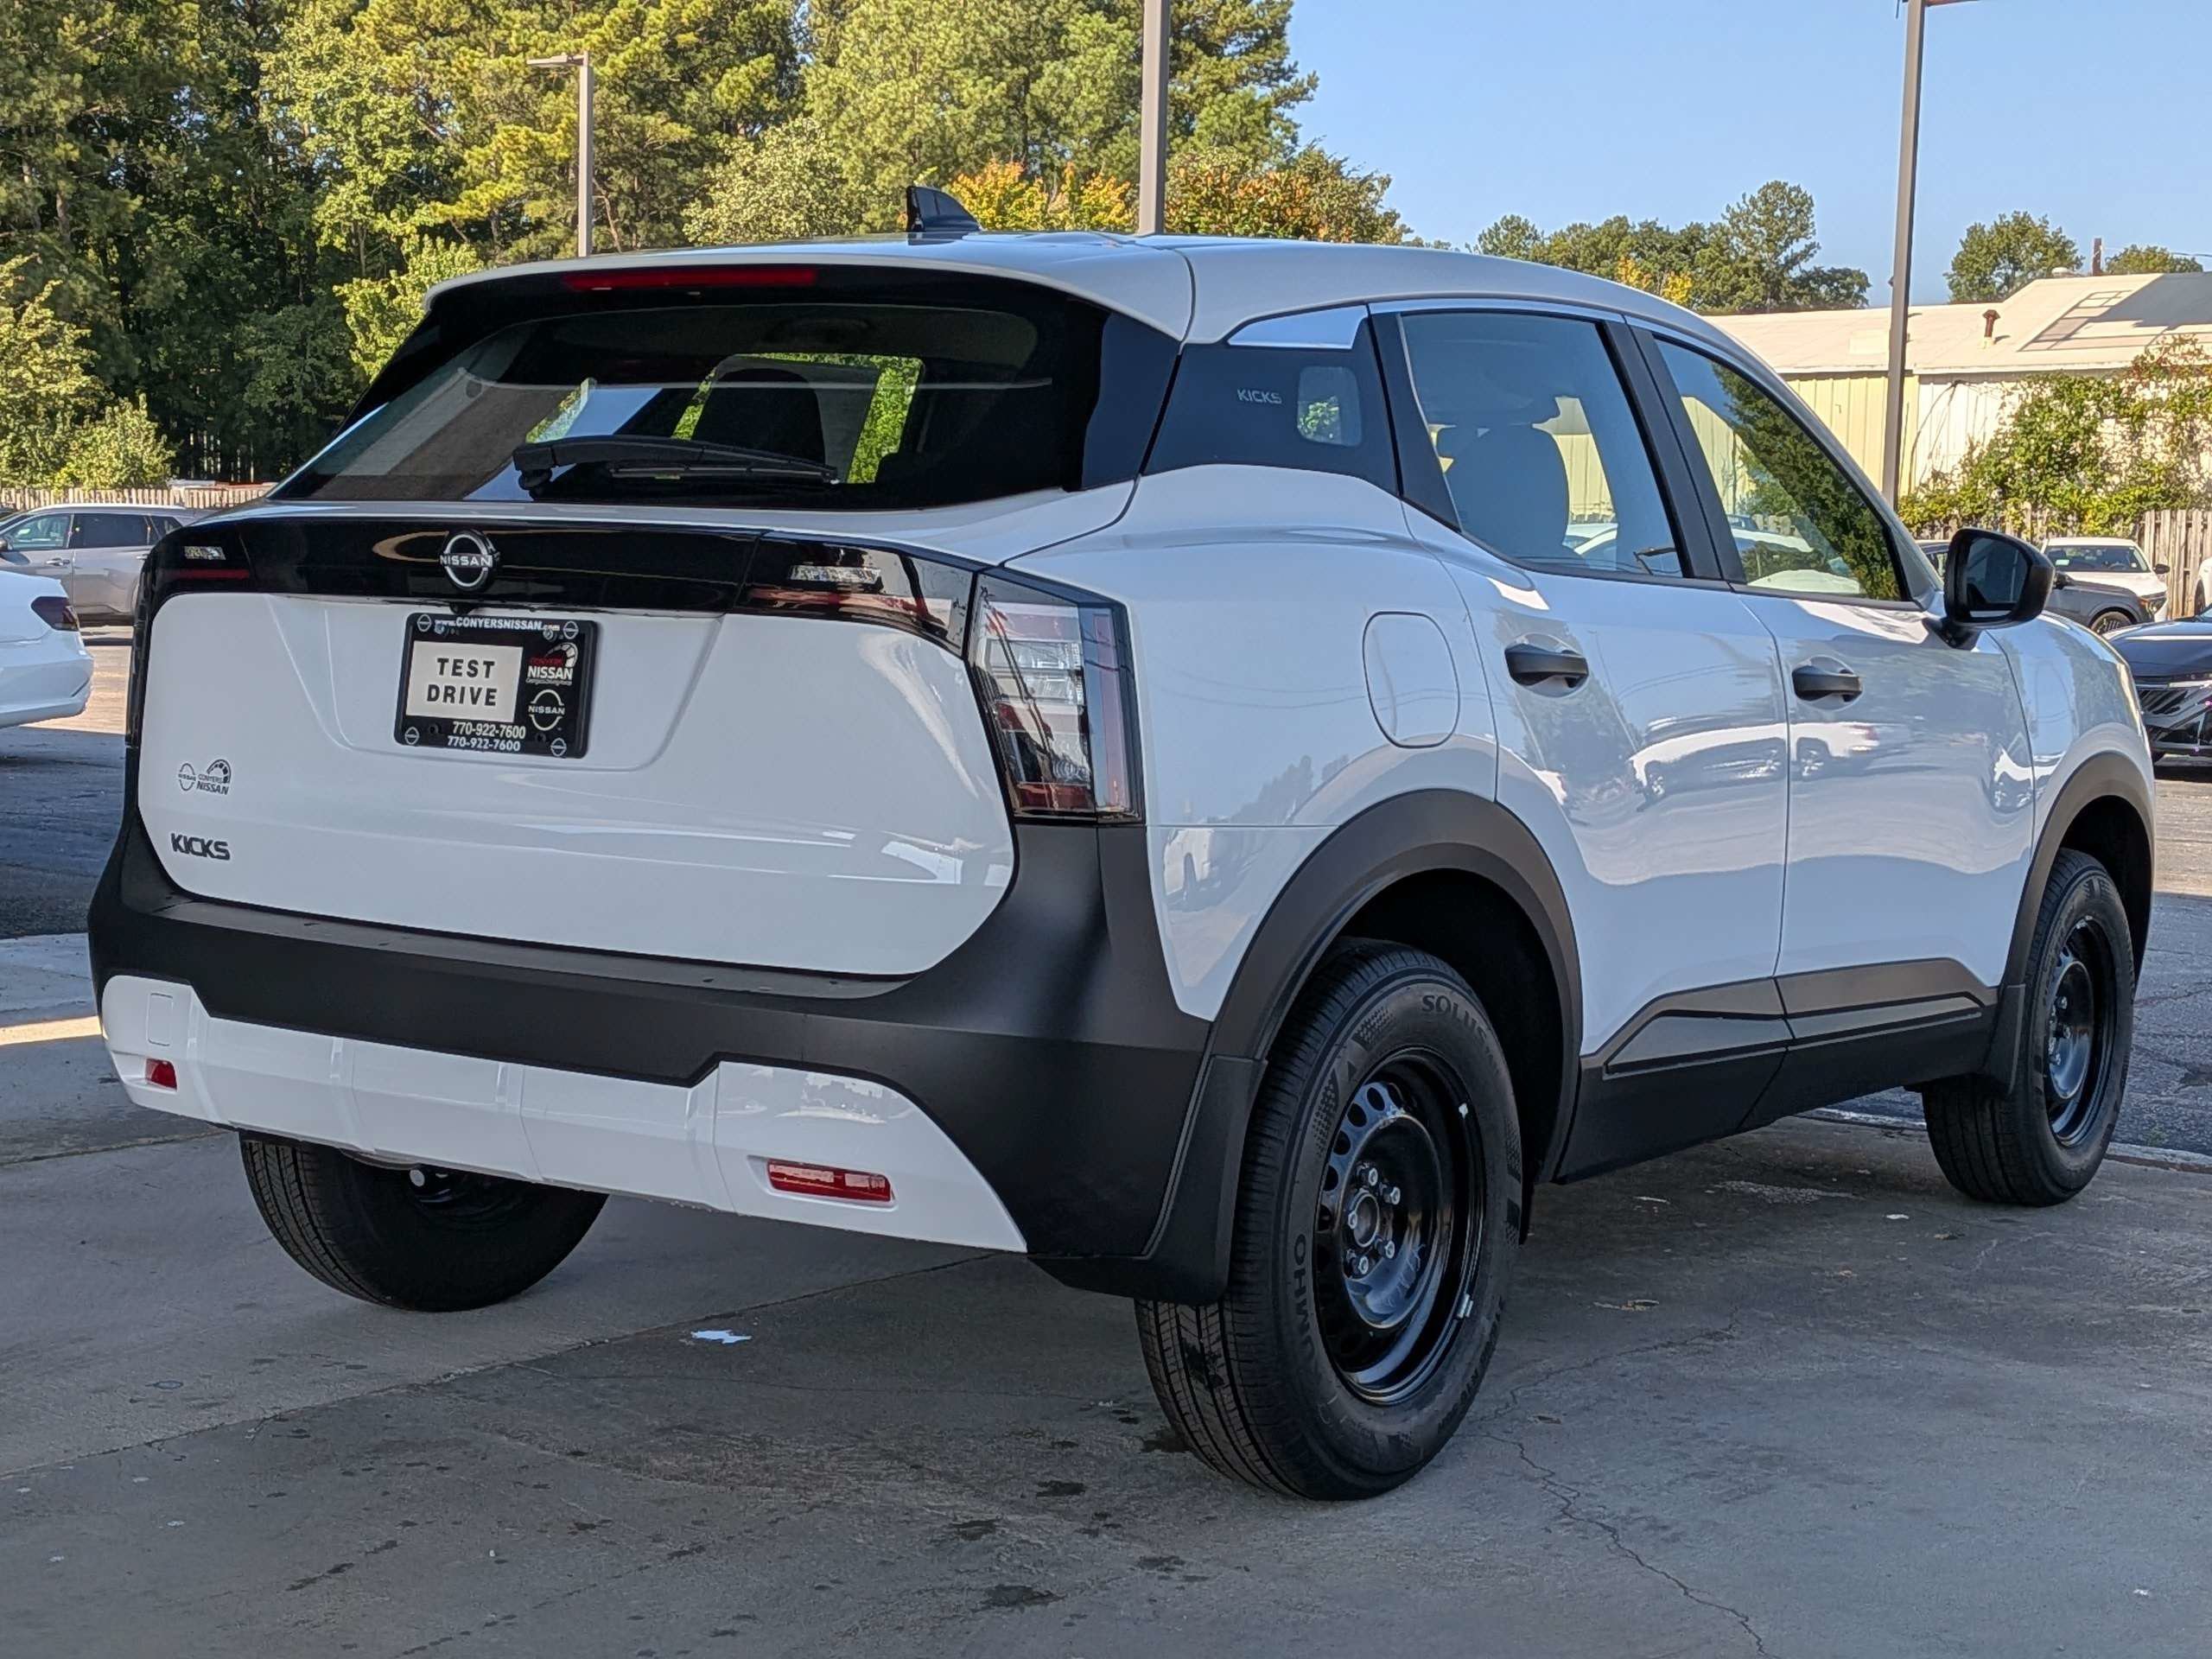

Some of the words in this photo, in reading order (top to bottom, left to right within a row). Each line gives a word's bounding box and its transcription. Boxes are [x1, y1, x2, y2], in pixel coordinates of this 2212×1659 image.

[1236, 389, 1282, 404] KICKS
[439, 554, 493, 568] NISSAN
[437, 658, 495, 678] TEST
[527, 665, 574, 681] NISSAN
[427, 683, 498, 706] DRIVE
[528, 705, 566, 715] NISSAN
[452, 721, 526, 740] 770-922-7600
[447, 735, 520, 752] 770-922-7600
[197, 780, 229, 796] NISSAN
[171, 832, 231, 861] KICKS
[1422, 994, 1487, 1045] SOLUS
